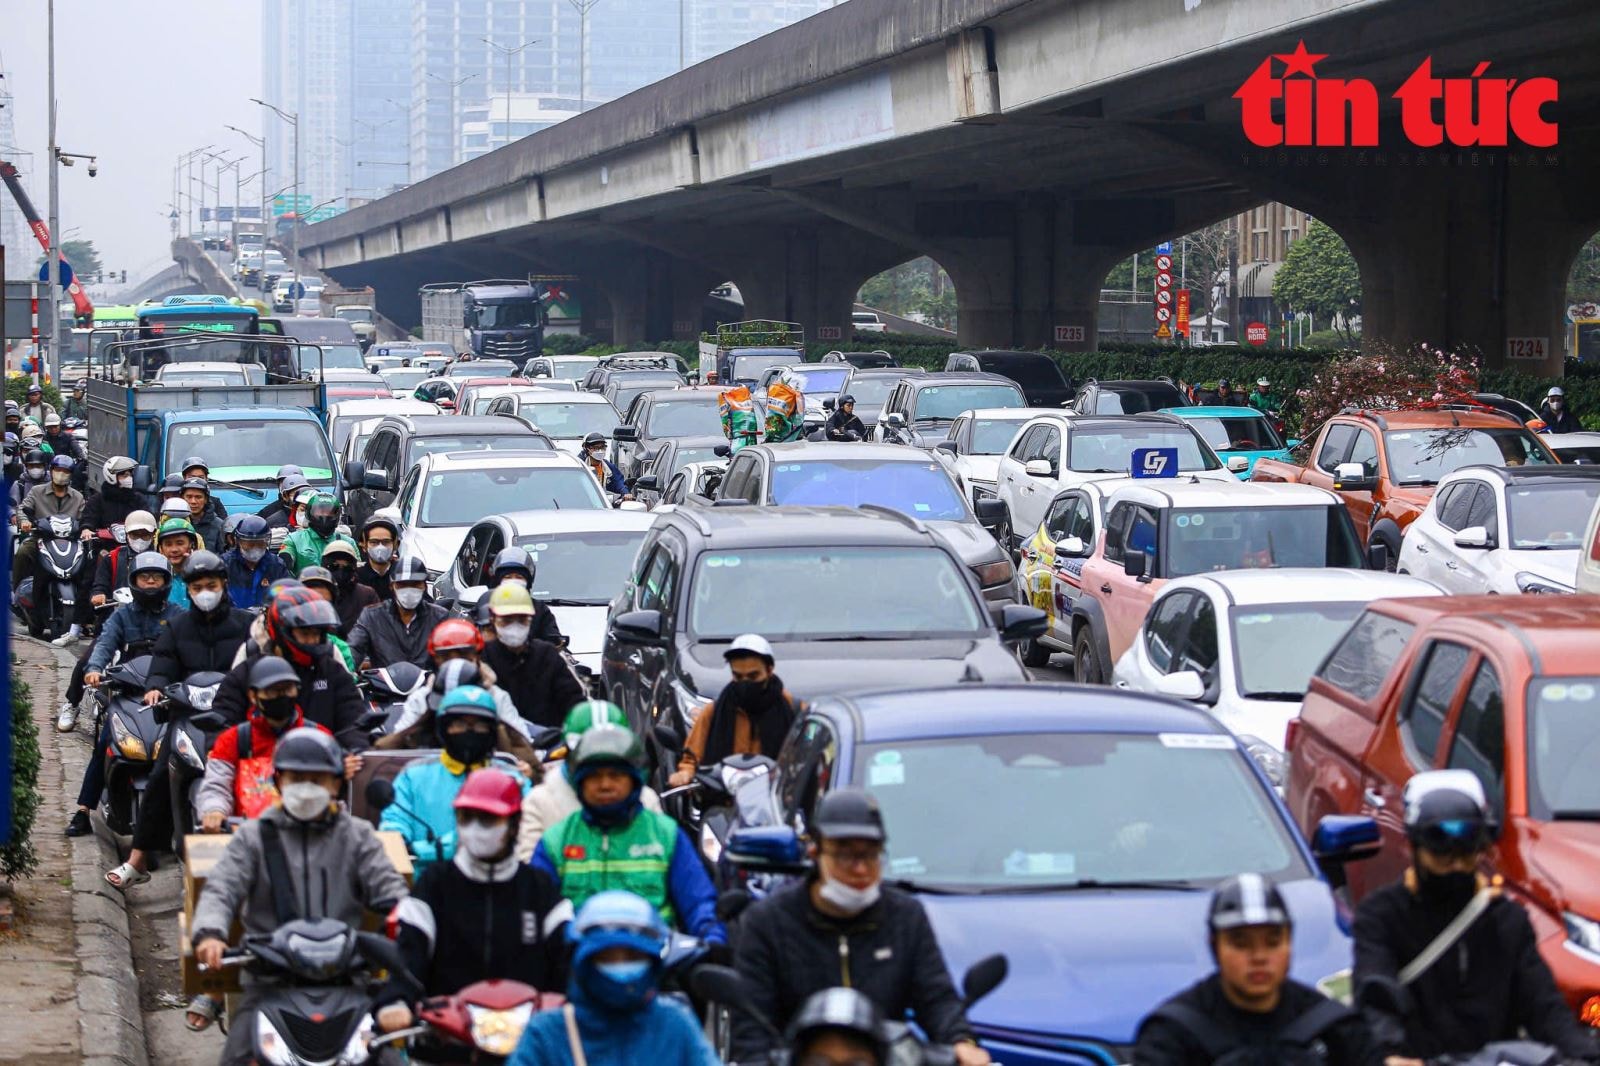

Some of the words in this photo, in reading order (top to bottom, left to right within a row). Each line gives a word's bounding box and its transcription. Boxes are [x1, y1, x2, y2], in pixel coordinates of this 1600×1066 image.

[1056, 327, 1082, 340] T235
[1248, 333, 1267, 341] HOME
[1509, 339, 1543, 357] T234
[1144, 451, 1168, 475] G7
